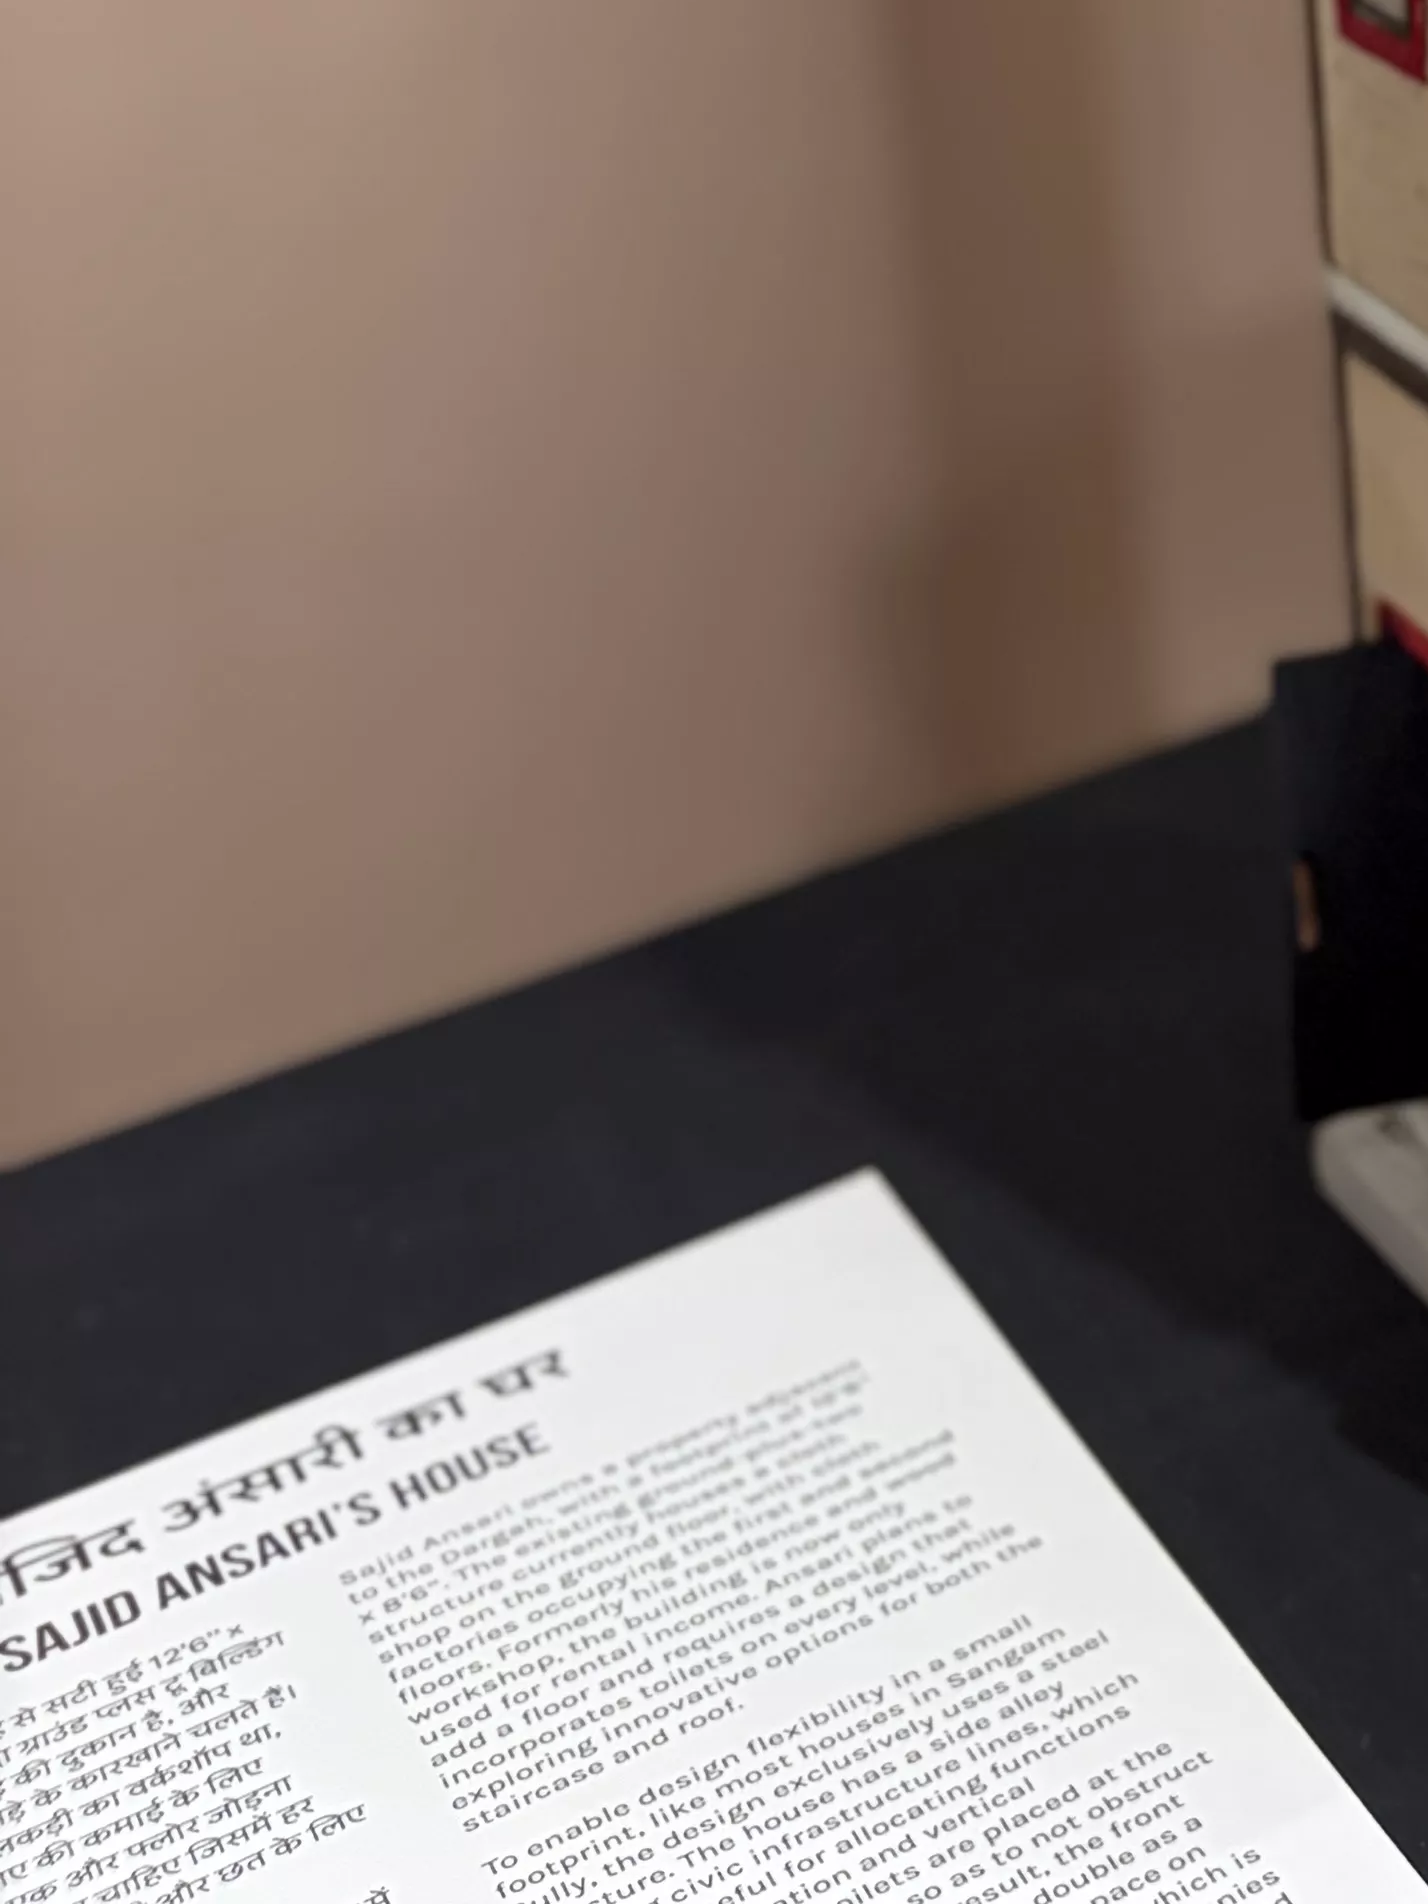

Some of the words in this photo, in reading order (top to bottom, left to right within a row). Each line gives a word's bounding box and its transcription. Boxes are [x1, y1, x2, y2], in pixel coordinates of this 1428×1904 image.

[0, 1520, 145, 1605] ाजिद
[162, 1425, 363, 1533] अंसारी
[377, 1391, 465, 1440] का
[479, 1349, 567, 1397] घर
[0, 1590, 141, 1672] SAJID
[156, 1492, 381, 1610] ANSARI'S
[389, 1428, 549, 1509] HOUSE
[338, 1545, 414, 1585] Sajid
[348, 1586, 378, 1605] to
[385, 1563, 433, 1588] the
[358, 1611, 375, 1625] x
[454, 1554, 507, 1580] The
[368, 1579, 504, 1644] structure
[378, 1626, 450, 1664] shop
[459, 1606, 495, 1628] on
[502, 1583, 550, 1609] the
[559, 1533, 659, 1590] ground
[388, 1620, 519, 1683] factories
[527, 1552, 677, 1623] occupying
[680, 1531, 727, 1556] the
[568, 1627, 616, 1654] the
[623, 1570, 748, 1630] building
[751, 1557, 777, 1574] is
[431, 1731, 487, 1767] add
[497, 1723, 513, 1737] a
[522, 1688, 587, 1725] floor
[599, 1657, 654, 1692] and
[663, 1606, 780, 1664] requires
[788, 1595, 805, 1608] a
[812, 1549, 907, 1597] design
[452, 1737, 598, 1810] exploring
[601, 1666, 757, 1742] innovative
[765, 1615, 874, 1668] options
[879, 1593, 917, 1616] for
[996, 1536, 1043, 1562] the
[496, 1599, 623, 1661] Formerly
[630, 1577, 677, 1602] his
[419, 1703, 492, 1745] used
[501, 1683, 540, 1709] for
[551, 1639, 636, 1688] rental
[439, 1696, 632, 1788] incorporates
[639, 1651, 733, 1699] toilets
[740, 1632, 777, 1654] on
[784, 1596, 856, 1634] every
[480, 1855, 518, 1875] To
[527, 1803, 630, 1856] enable
[638, 1754, 740, 1805] design
[747, 1685, 883, 1755] flexibility
[890, 1670, 921, 1689] in
[928, 1658, 946, 1673] a
[952, 1614, 1032, 1661] small
[603, 1847, 654, 1876] the
[663, 1796, 765, 1849] design
[773, 1715, 933, 1798] exclusively
[942, 1681, 1010, 1718] uses
[1017, 1669, 1034, 1684] a
[1041, 1629, 1109, 1671] steel
[649, 1796, 706, 1827] like
[715, 1755, 792, 1798] most
[797, 1704, 904, 1759] houses
[910, 1687, 941, 1706] in
[946, 1628, 1066, 1688] Sangam
[463, 1762, 604, 1832] staircase
[613, 1728, 669, 1764] and
[671, 1862, 743, 1904] civic
[749, 1759, 961, 1865] infrastructure
[1051, 1674, 1138, 1720] which
[677, 1838, 735, 1867] The
[742, 1791, 835, 1840] house
[841, 1761, 897, 1793] has
[905, 1750, 922, 1764] a
[930, 1717, 990, 1752] side
[999, 1681, 1063, 1720] alley
[784, 1850, 825, 1878] for
[835, 1774, 988, 1854] allocating
[990, 1706, 1130, 1779] functions
[859, 1833, 916, 1872] and
[922, 1776, 1035, 1839] vertical
[928, 1839, 975, 1868] are
[983, 1784, 1080, 1846] placed
[1088, 1768, 1118, 1790] at
[1123, 1743, 1172, 1772] the
[950, 1864, 986, 1887] as
[991, 1846, 1023, 1866] to
[1031, 1816, 1081, 1848] not
[1087, 1752, 1213, 1819] obstruct
[1054, 1836, 1104, 1866] the
[1110, 1795, 1184, 1838] front
[1033, 1851, 1135, 1904] double
[1142, 1830, 1178, 1853] as
[1184, 1817, 1203, 1832] a
[1153, 1867, 1227, 1904] hich
[1231, 1849, 1261, 1869] is
[1168, 1847, 1206, 1871] on
